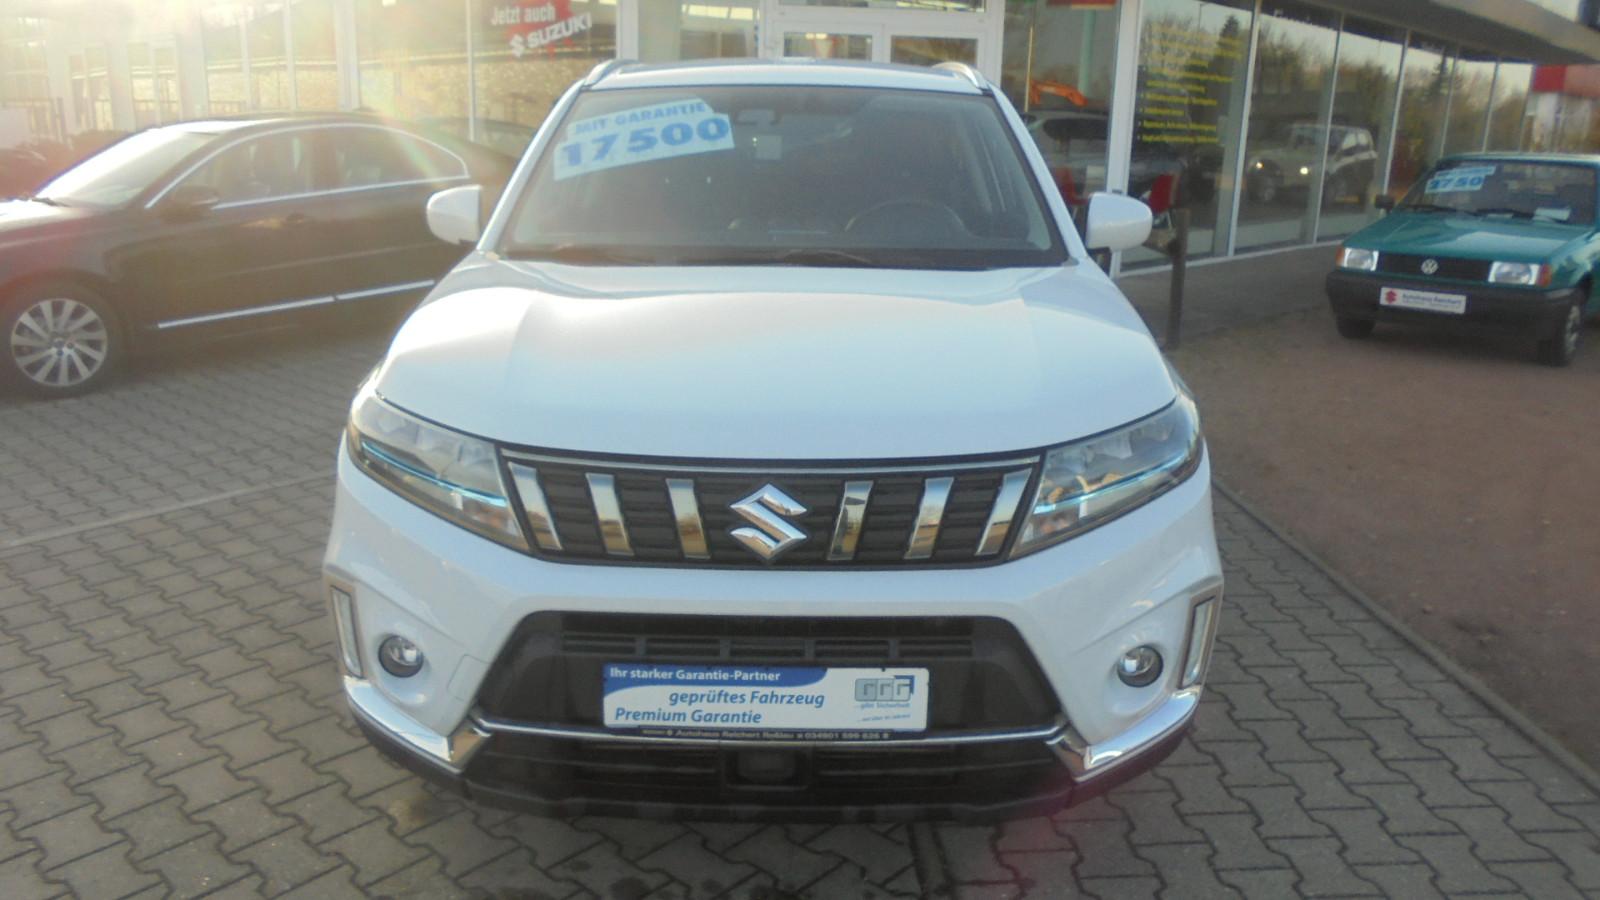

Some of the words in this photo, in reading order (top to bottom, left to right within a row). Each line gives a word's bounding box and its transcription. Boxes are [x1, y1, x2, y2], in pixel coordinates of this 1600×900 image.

[491, 6, 519, 25] Jetzt
[524, 3, 556, 22] auch
[528, 13, 592, 47] SUZUKI
[575, 117, 608, 134] MIT
[615, 102, 705, 125] GARANTIE
[563, 117, 729, 167] 17500
[610, 667, 627, 678] Ihr
[630, 668, 673, 680] starker
[676, 669, 781, 681] Garantie-Partner
[669, 689, 746, 706] geprüftes
[750, 691, 825, 709] Fahrzeug
[615, 707, 687, 722] Premium
[691, 709, 762, 724] Garantie
